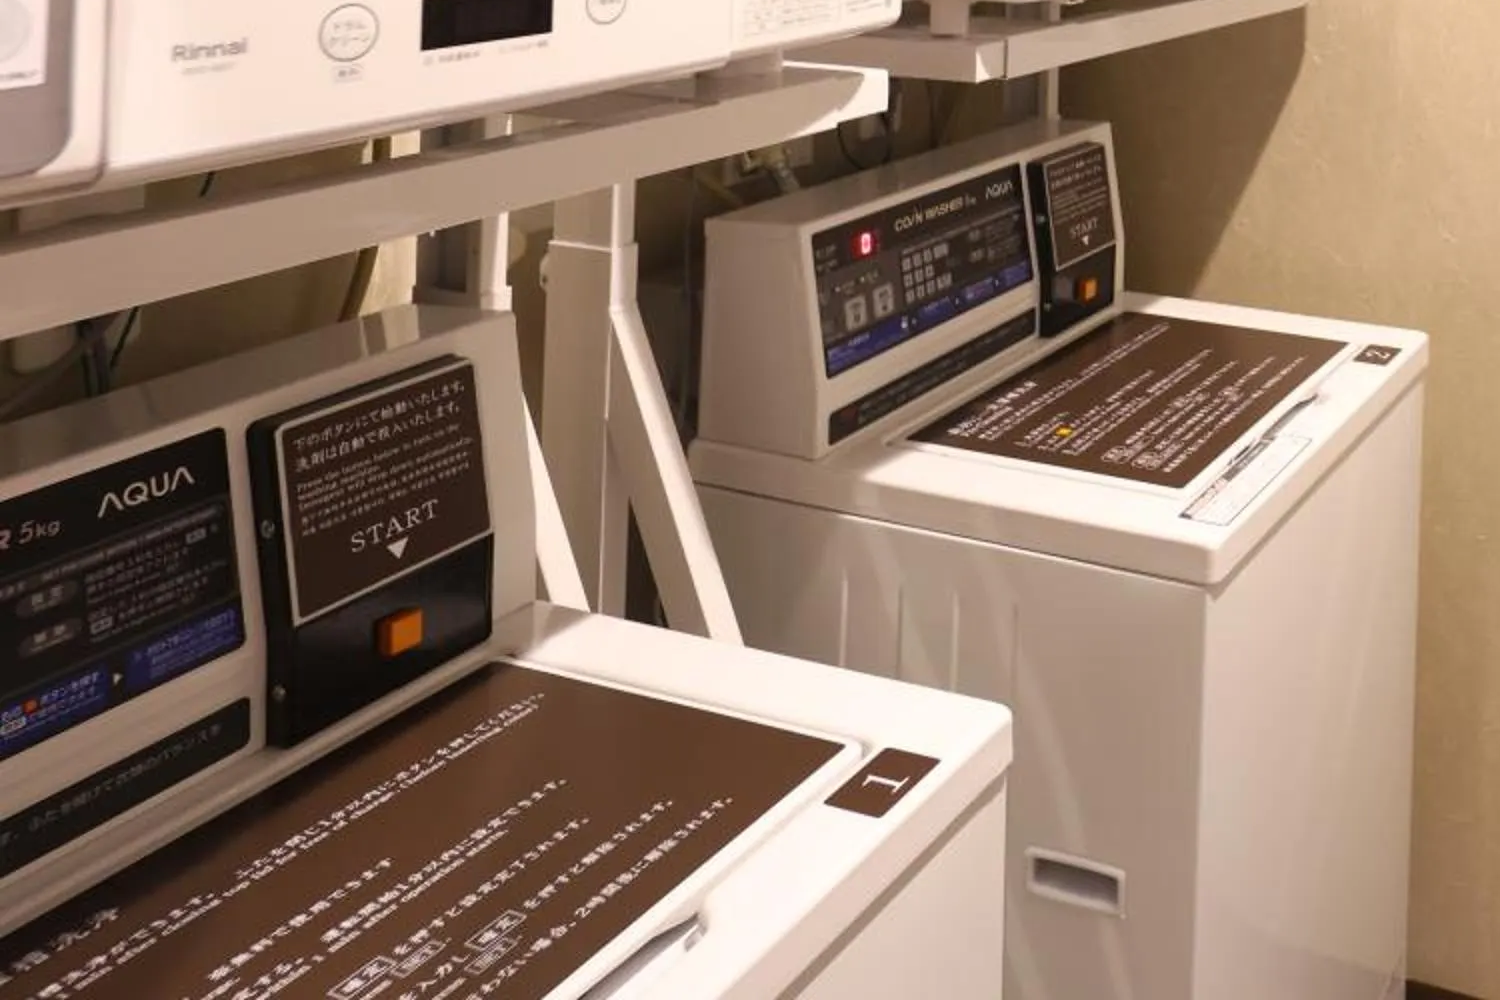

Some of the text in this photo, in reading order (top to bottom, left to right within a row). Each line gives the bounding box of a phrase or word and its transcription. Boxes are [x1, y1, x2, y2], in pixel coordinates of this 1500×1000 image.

[171, 36, 249, 64] Rinnai
[97, 465, 195, 518] AQUA
[350, 498, 439, 553] START
[861, 773, 911, 796] 1
